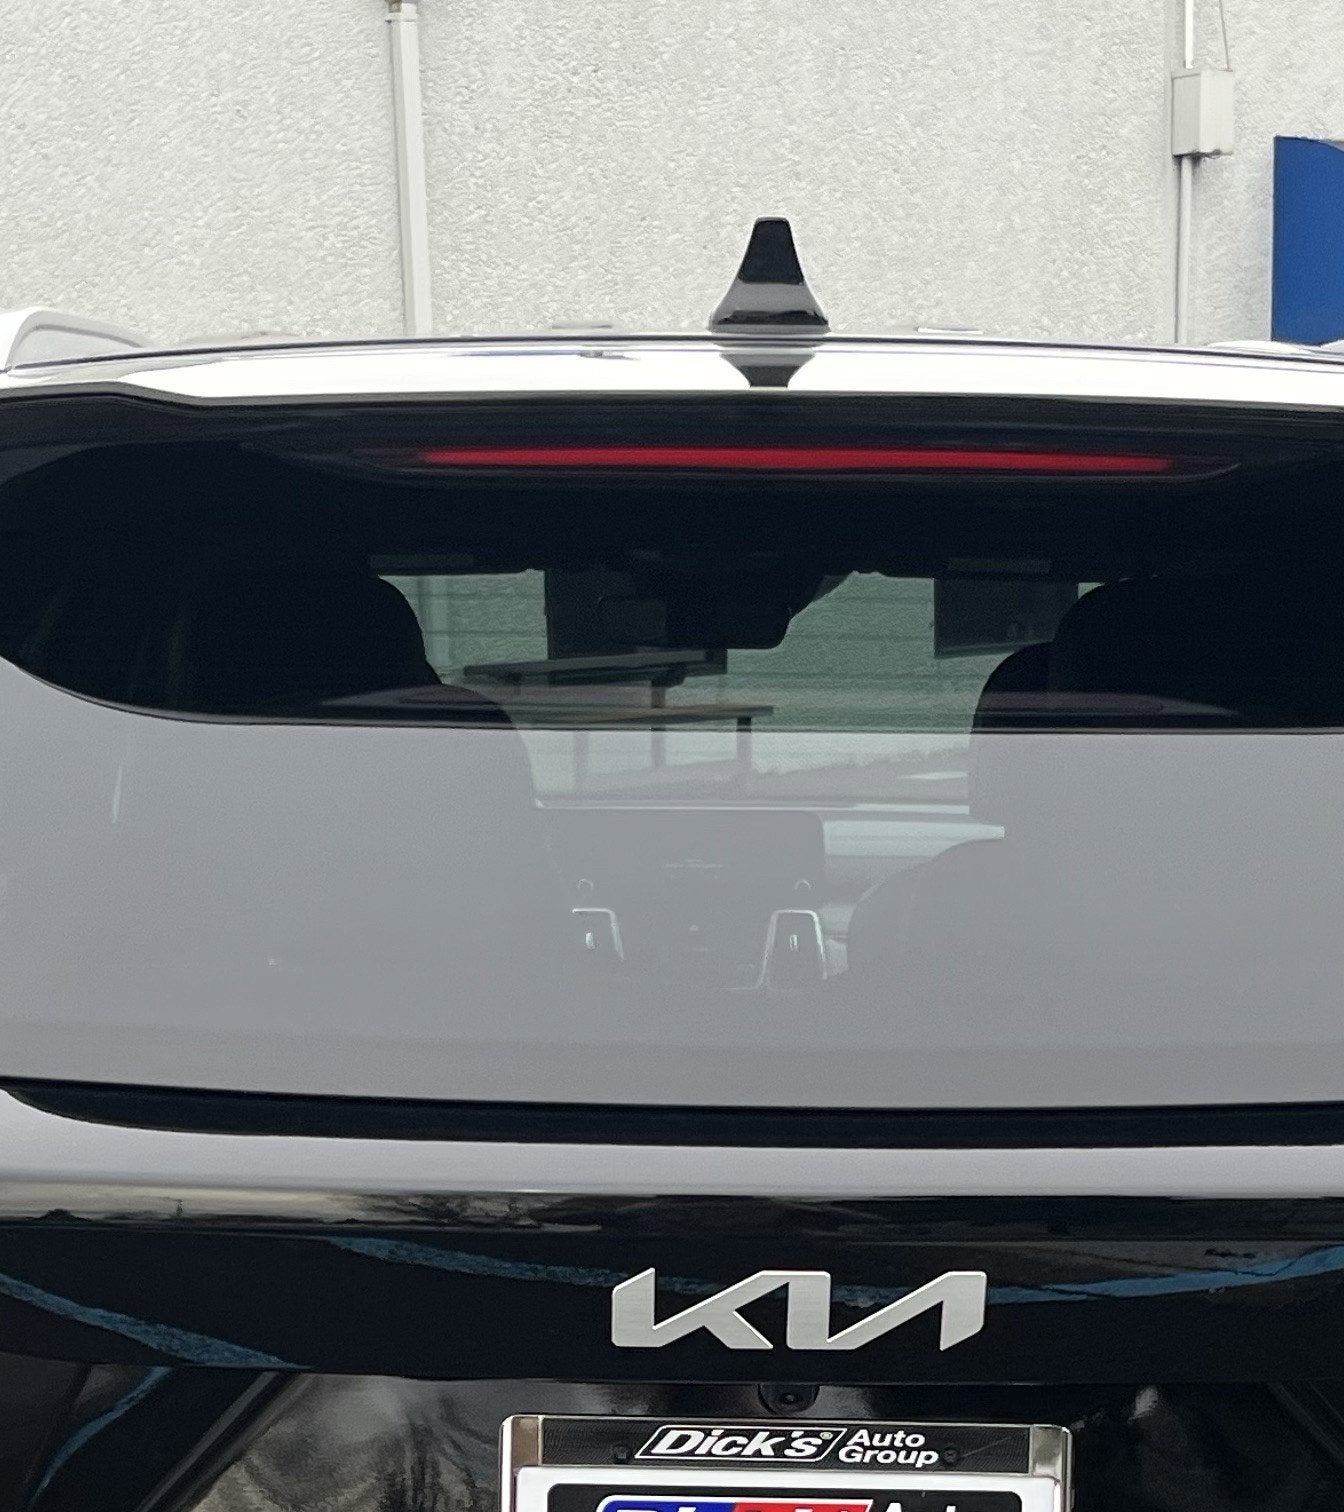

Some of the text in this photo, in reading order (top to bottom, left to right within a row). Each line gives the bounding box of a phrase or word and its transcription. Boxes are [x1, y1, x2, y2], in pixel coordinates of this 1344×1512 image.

[612, 1268, 986, 1350] KIA
[651, 1429, 822, 1457] Dick's
[847, 1429, 926, 1448] Auto
[838, 1446, 940, 1468] Group
